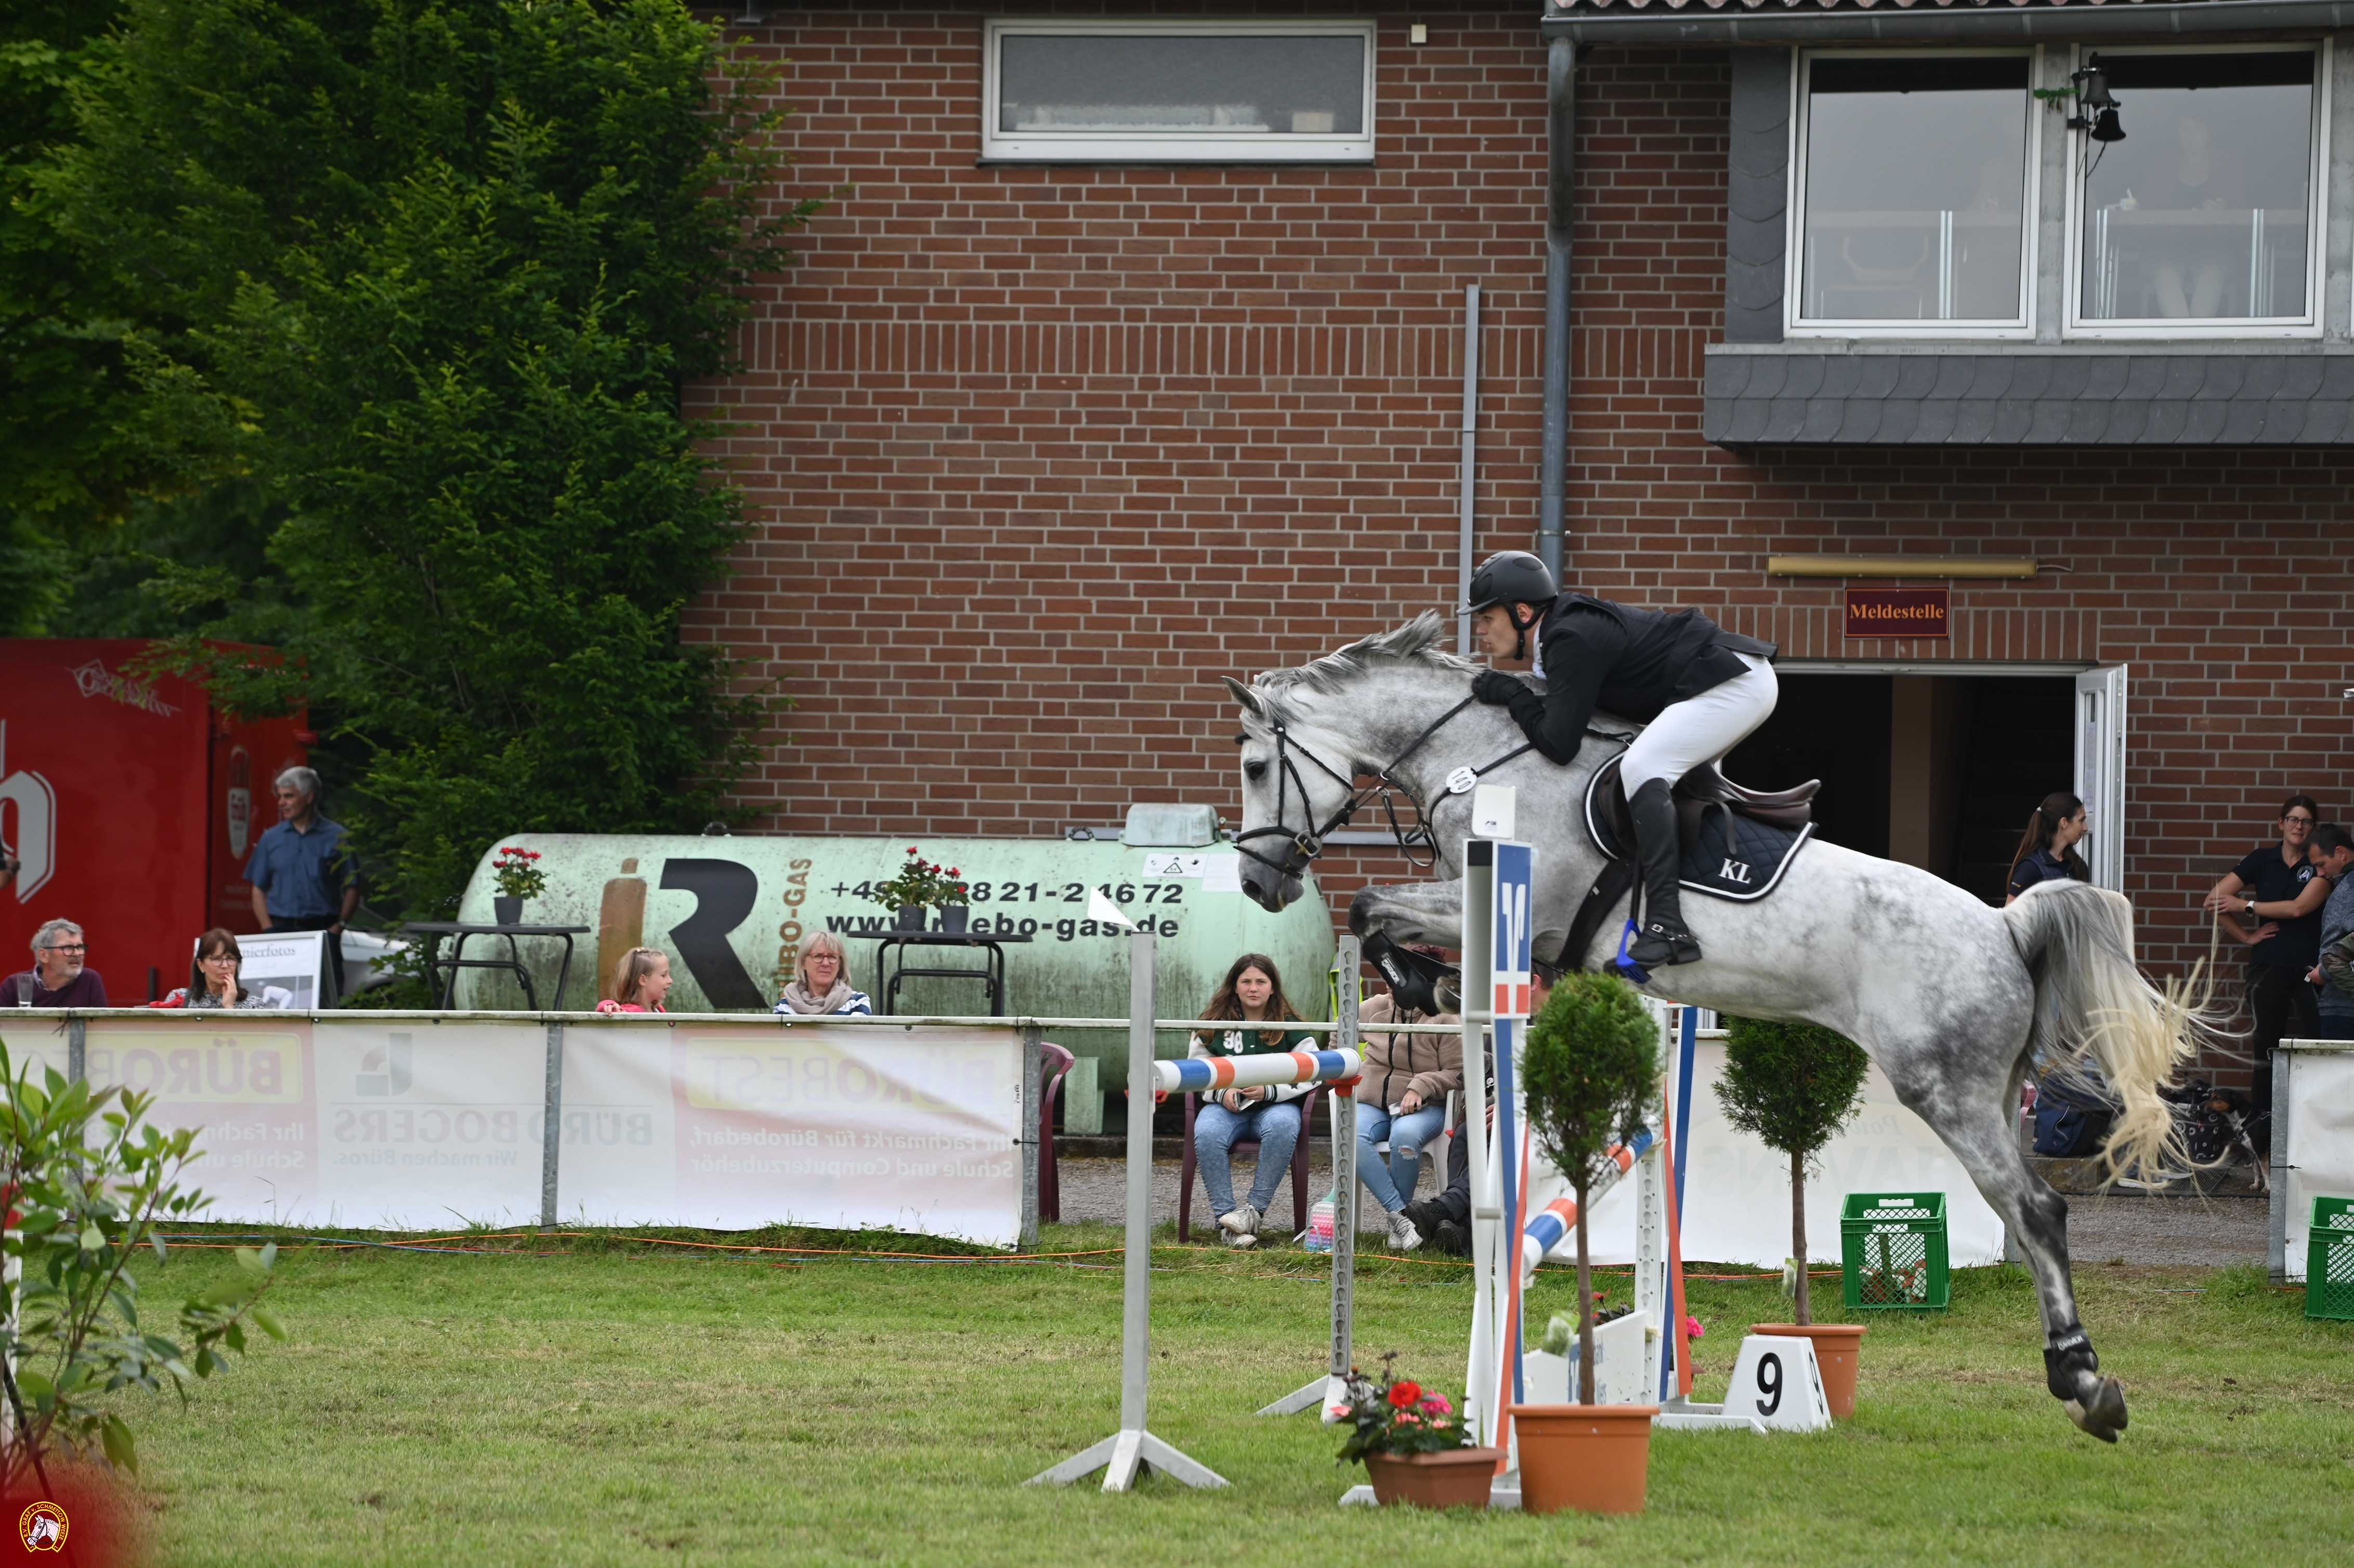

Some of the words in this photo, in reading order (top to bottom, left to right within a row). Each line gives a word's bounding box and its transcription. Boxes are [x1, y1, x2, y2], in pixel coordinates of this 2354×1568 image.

[1850, 604, 1944, 619] Meldestelle
[1719, 858, 1751, 885] KL
[778, 858, 813, 998] BO-GAS
[241, 943, 296, 958] nierfotos
[1756, 1352, 1783, 1417] 9
